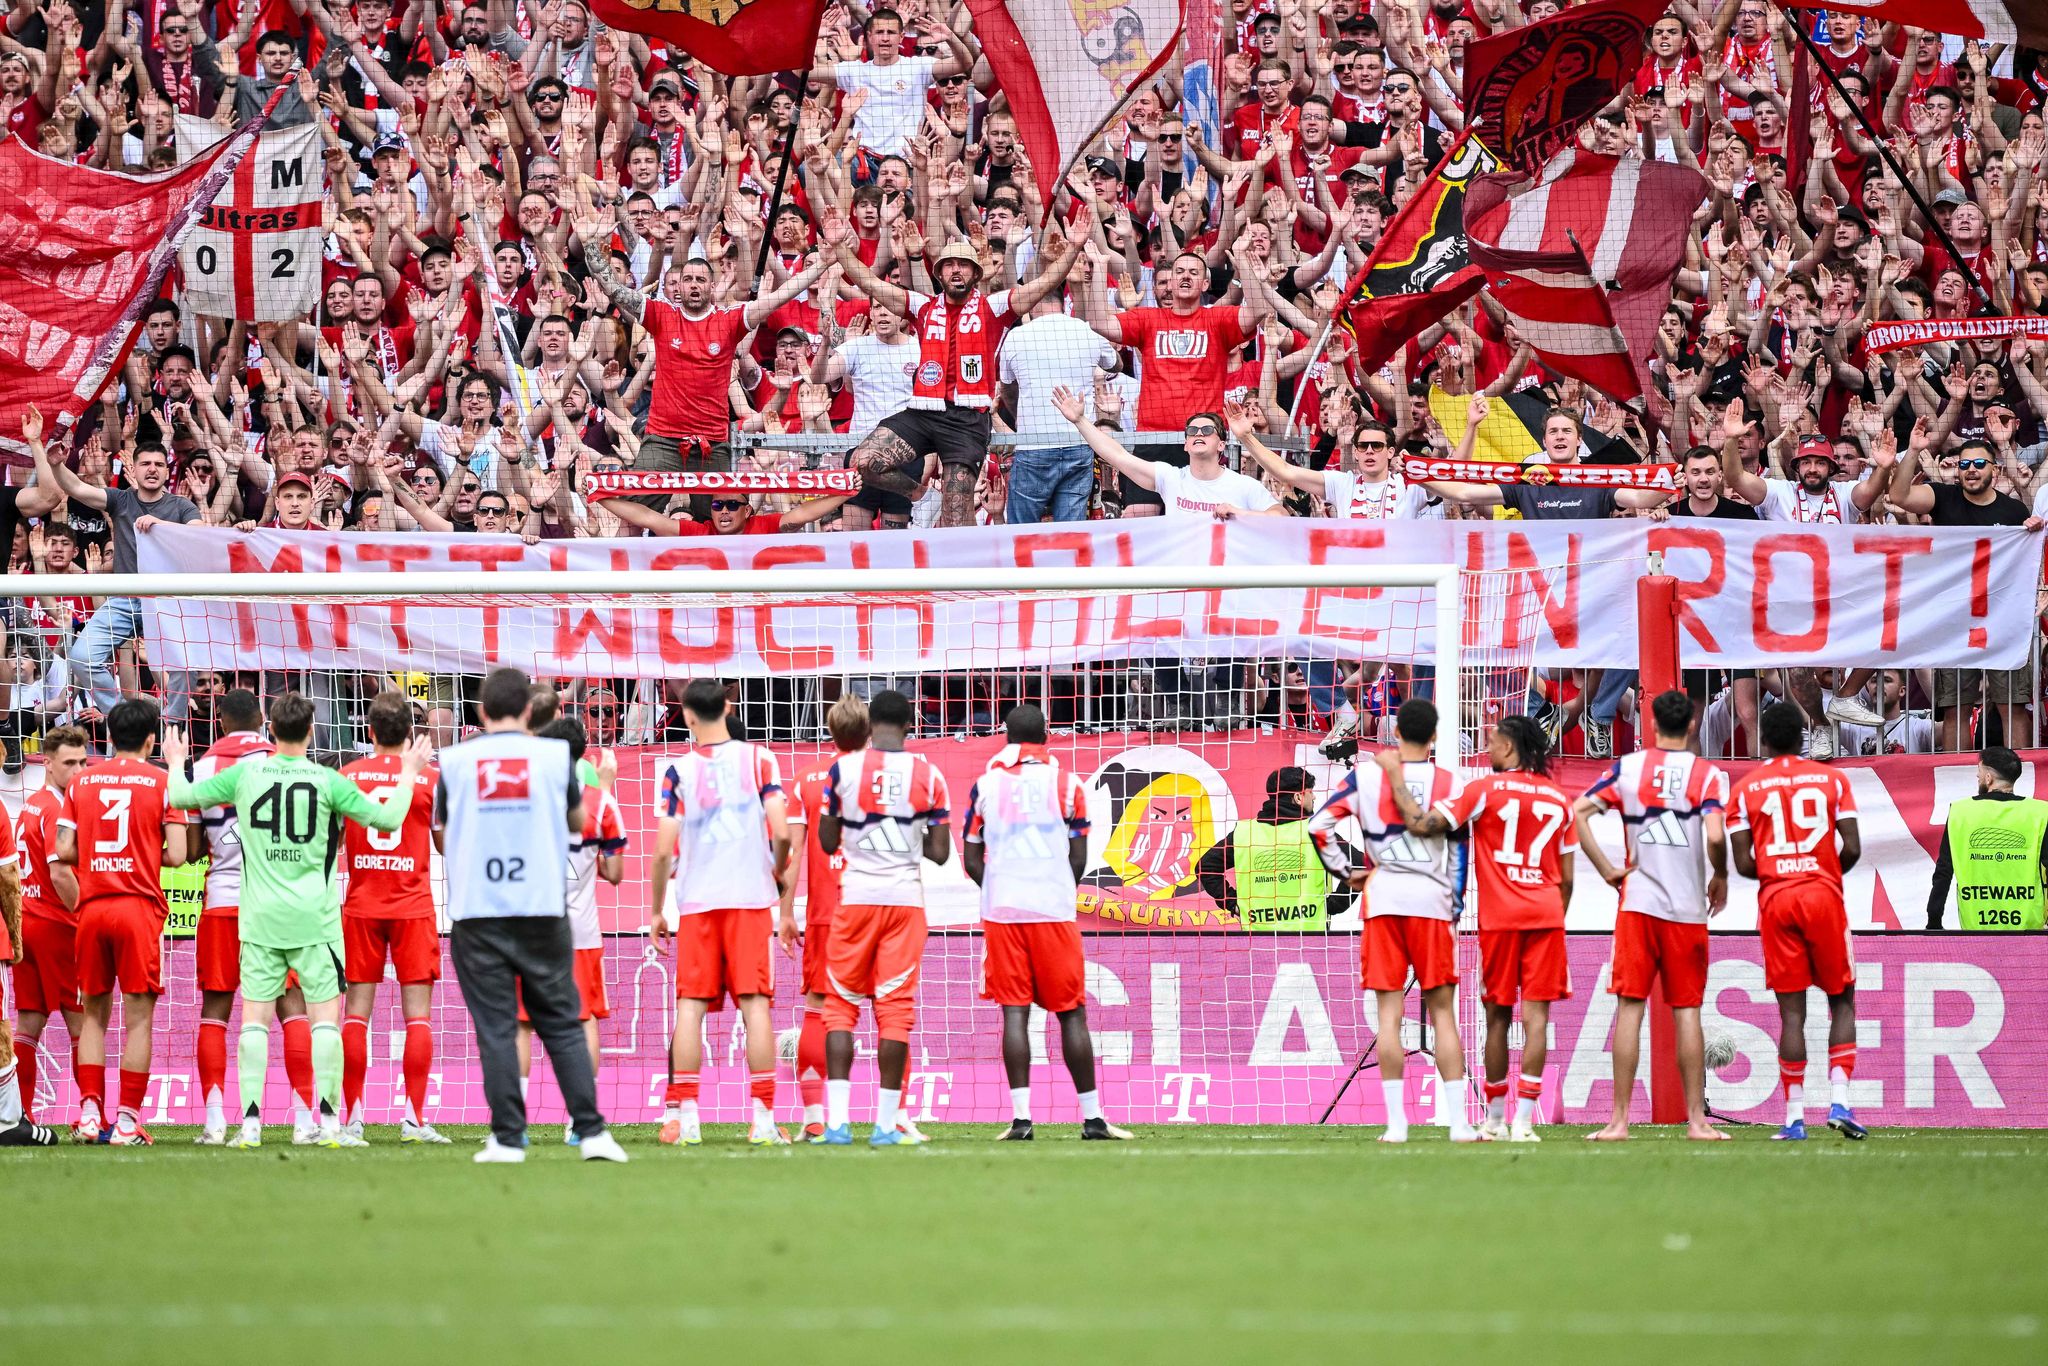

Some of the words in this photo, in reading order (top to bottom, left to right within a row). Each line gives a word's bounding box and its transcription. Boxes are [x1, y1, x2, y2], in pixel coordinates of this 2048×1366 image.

[271, 157, 303, 189] M
[196, 245, 216, 275] 0
[271, 248, 296, 278] 2
[587, 472, 790, 494] DURCHBOXEN
[1405, 460, 1518, 482] SCHIC
[1559, 467, 1677, 490] KERIA
[227, 540, 935, 672] MITTWOCH
[1013, 524, 1386, 651] ALLE
[1466, 531, 1581, 650] IN
[90, 775, 119, 785] BAYERN
[94, 788, 132, 853] 3
[251, 782, 317, 844] 40
[1761, 788, 1829, 857] 19
[1493, 798, 1564, 867] 17
[90, 857, 133, 872] MINJAE
[265, 849, 302, 863] URBIG
[354, 855, 414, 872] GORETZKA
[1970, 853, 1993, 861] Allianz
[2006, 853, 2026, 861] Arena
[486, 858, 525, 882] 02
[1776, 856, 1820, 875] DAVIES
[1254, 875, 1277, 884] Allianz
[1507, 867, 1543, 884] OLISE
[164, 889, 205, 903] TEWA
[1961, 886, 2035, 900] STEWARD
[1248, 904, 1317, 922] STEWARD
[1978, 910, 2021, 925] 1266
